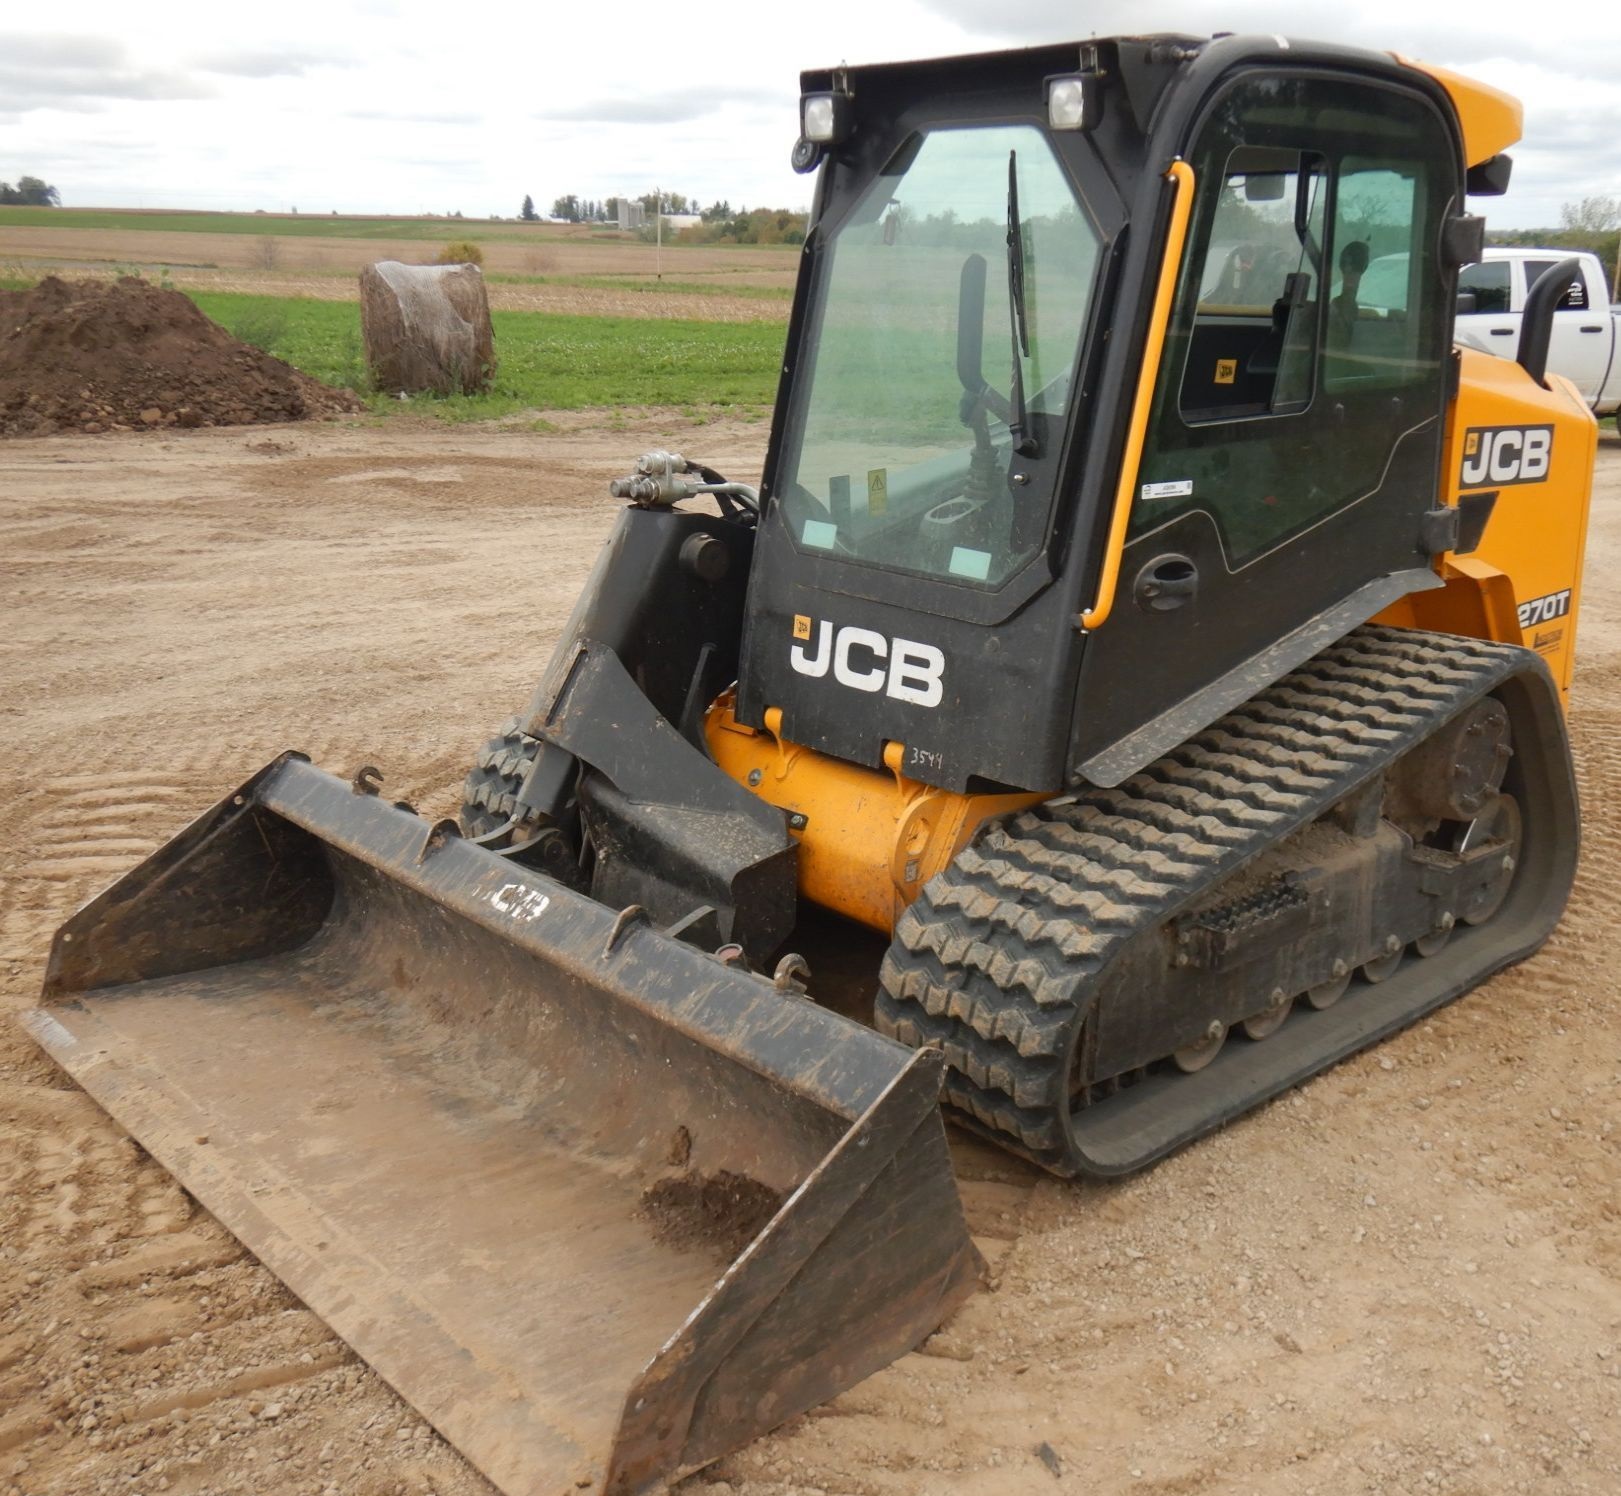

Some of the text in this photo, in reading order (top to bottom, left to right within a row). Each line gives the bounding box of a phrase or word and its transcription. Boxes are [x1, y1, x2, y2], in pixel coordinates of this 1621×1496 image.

[1462, 429, 1551, 484] JCB
[1517, 590, 1570, 628] 270T
[790, 620, 945, 708] JCB
